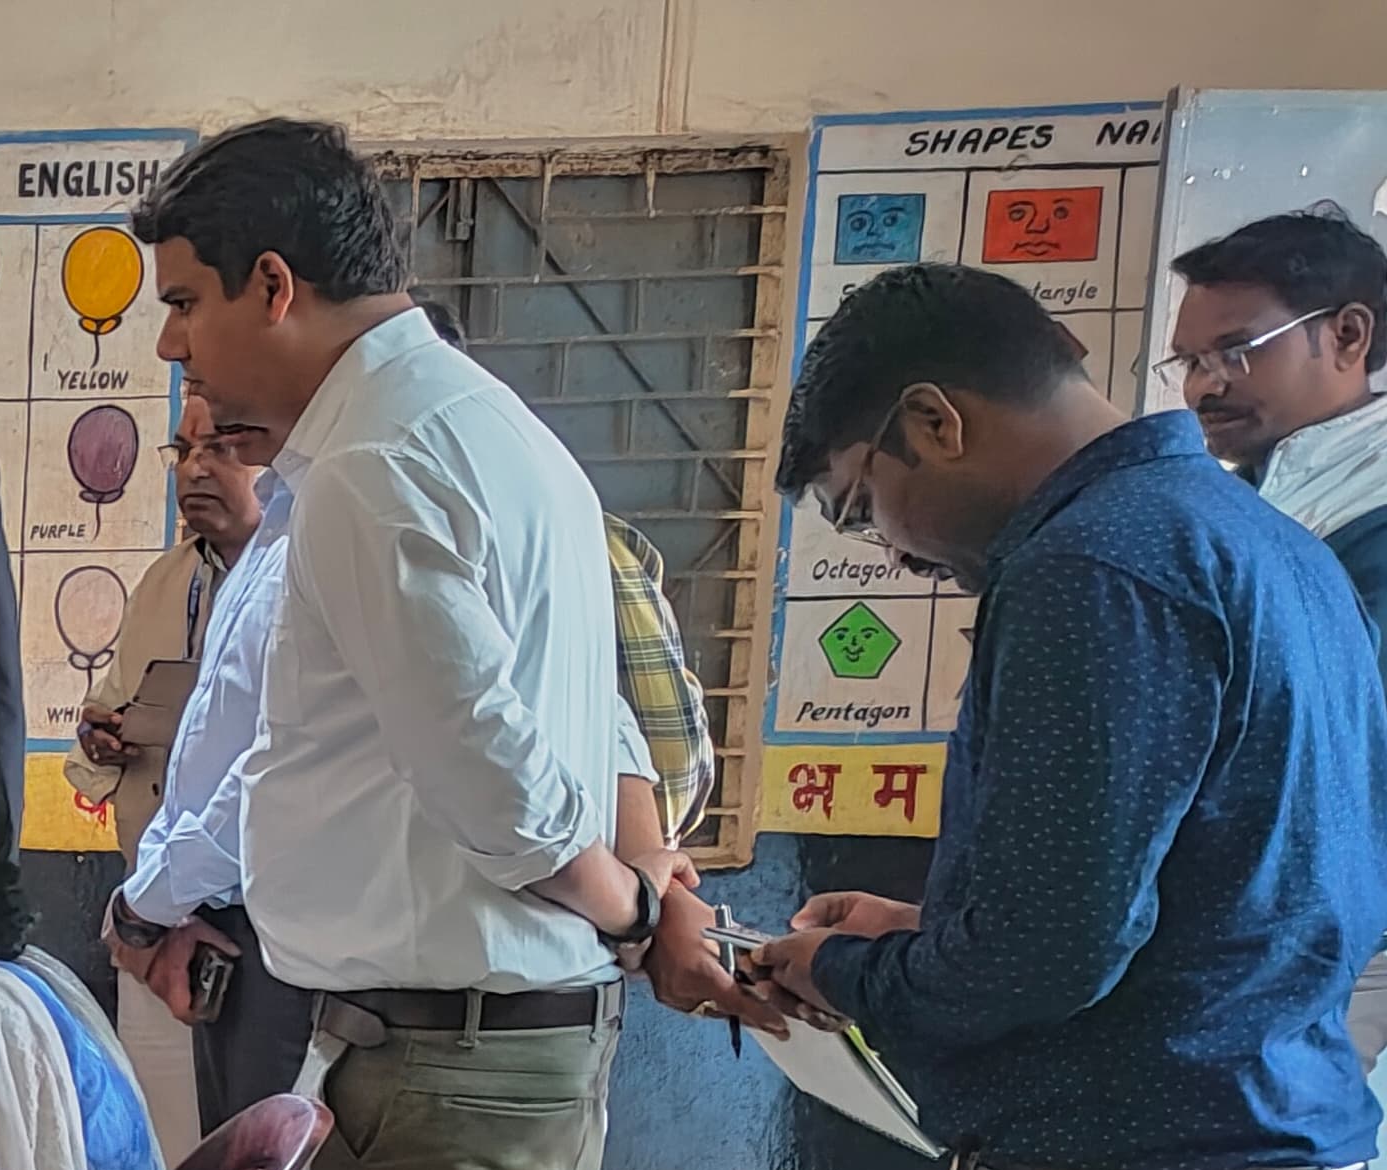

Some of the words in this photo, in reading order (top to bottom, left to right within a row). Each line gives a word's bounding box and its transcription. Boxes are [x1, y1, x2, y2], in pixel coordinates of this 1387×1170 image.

[905, 124, 1054, 156] SHAPES
[17, 160, 160, 198] ENGLISH
[1032, 281, 1098, 304] tangle
[58, 368, 129, 390] YELLOW
[30, 523, 86, 540] PURPLE
[47, 706, 79, 723] WHI
[795, 701, 911, 730] Pentagon
[871, 764, 927, 823] म
